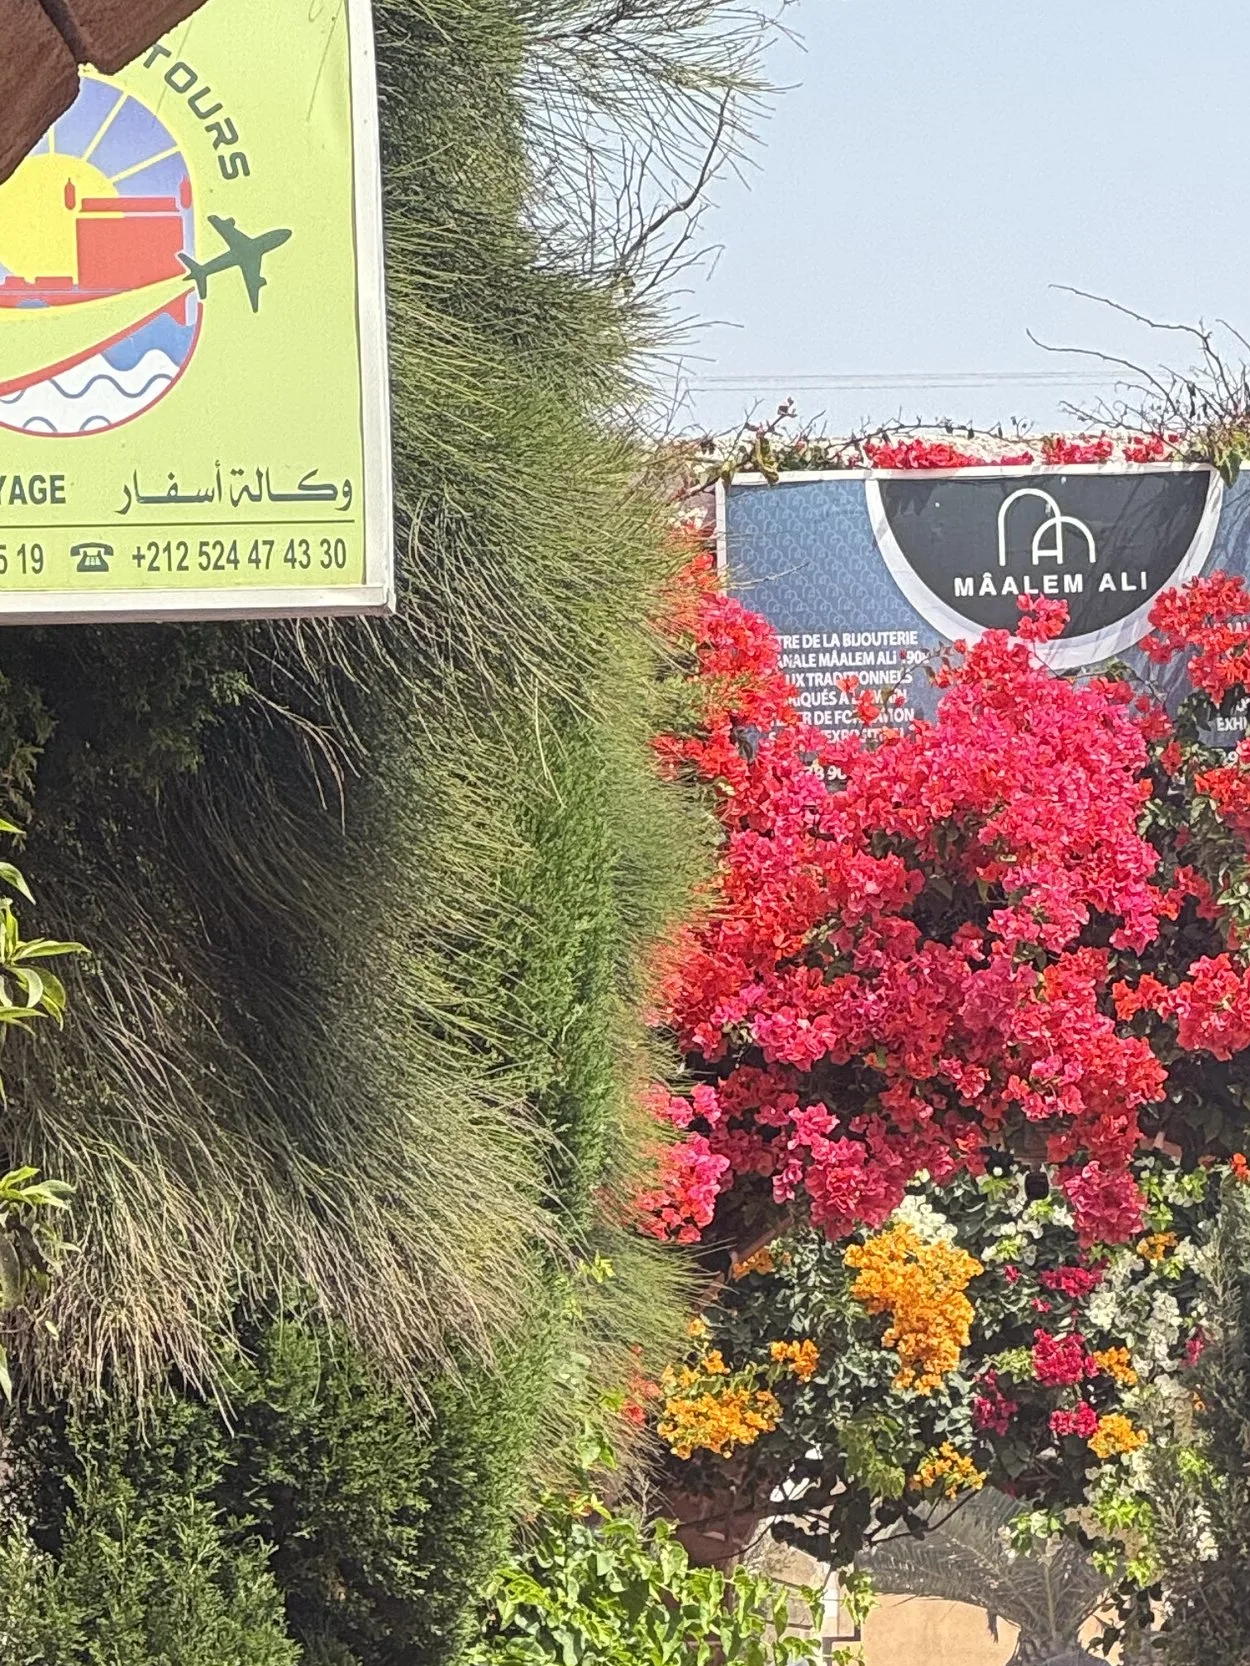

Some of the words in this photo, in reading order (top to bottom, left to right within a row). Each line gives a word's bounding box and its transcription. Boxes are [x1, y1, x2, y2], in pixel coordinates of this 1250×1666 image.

[143, 44, 251, 181] TOURS
[113, 459, 223, 515] أسفار
[229, 466, 353, 512] وكالة
[17, 543, 44, 574] 19
[132, 540, 189, 572] +212
[198, 539, 240, 571] 524
[247, 538, 275, 570] 47
[283, 538, 311, 569] 43
[319, 538, 347, 569] 30
[954, 572, 1084, 597] MÂALEM
[1098, 571, 1148, 593] ALI
[801, 633, 821, 649] DE
[822, 633, 841, 648] LA
[842, 631, 918, 648] BIJOUTERIE
[818, 649, 875, 667] MÂALEM
[813, 710, 833, 726] DE
